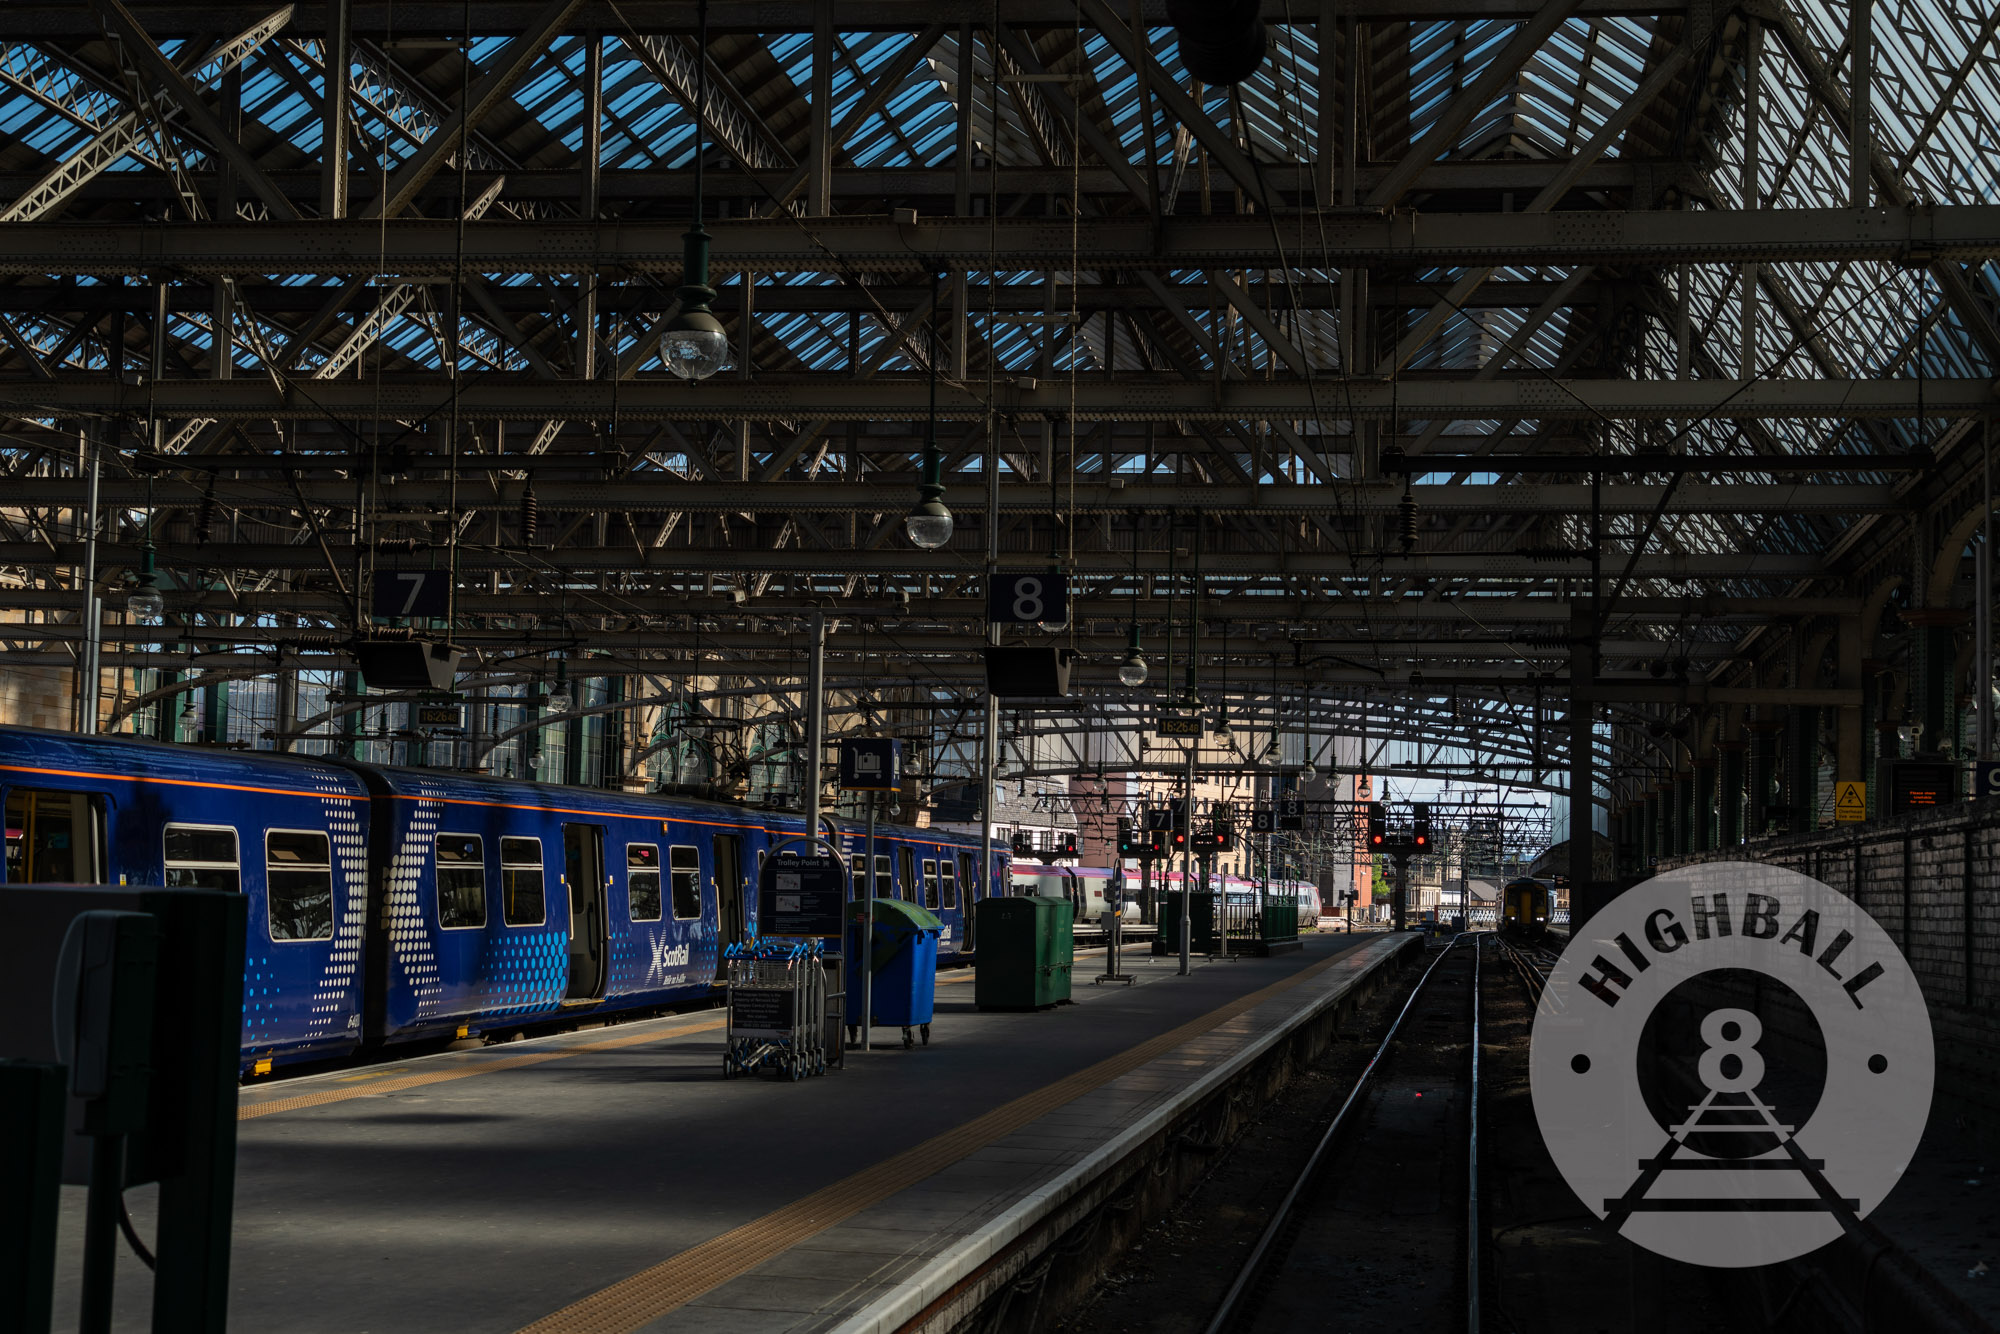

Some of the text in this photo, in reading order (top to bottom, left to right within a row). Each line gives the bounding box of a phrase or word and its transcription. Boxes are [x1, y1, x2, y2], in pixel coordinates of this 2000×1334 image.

[397, 573, 426, 614] 7
[1013, 577, 1044, 620] 8
[1161, 720, 1188, 733] 16:26
[770, 794, 780, 806] 6
[1288, 801, 1297, 814] 8
[1155, 813, 1165, 827] 7
[1258, 814, 1268, 829] 8
[777, 859, 800, 867] Trolley
[663, 943, 690, 967] ScotRail
